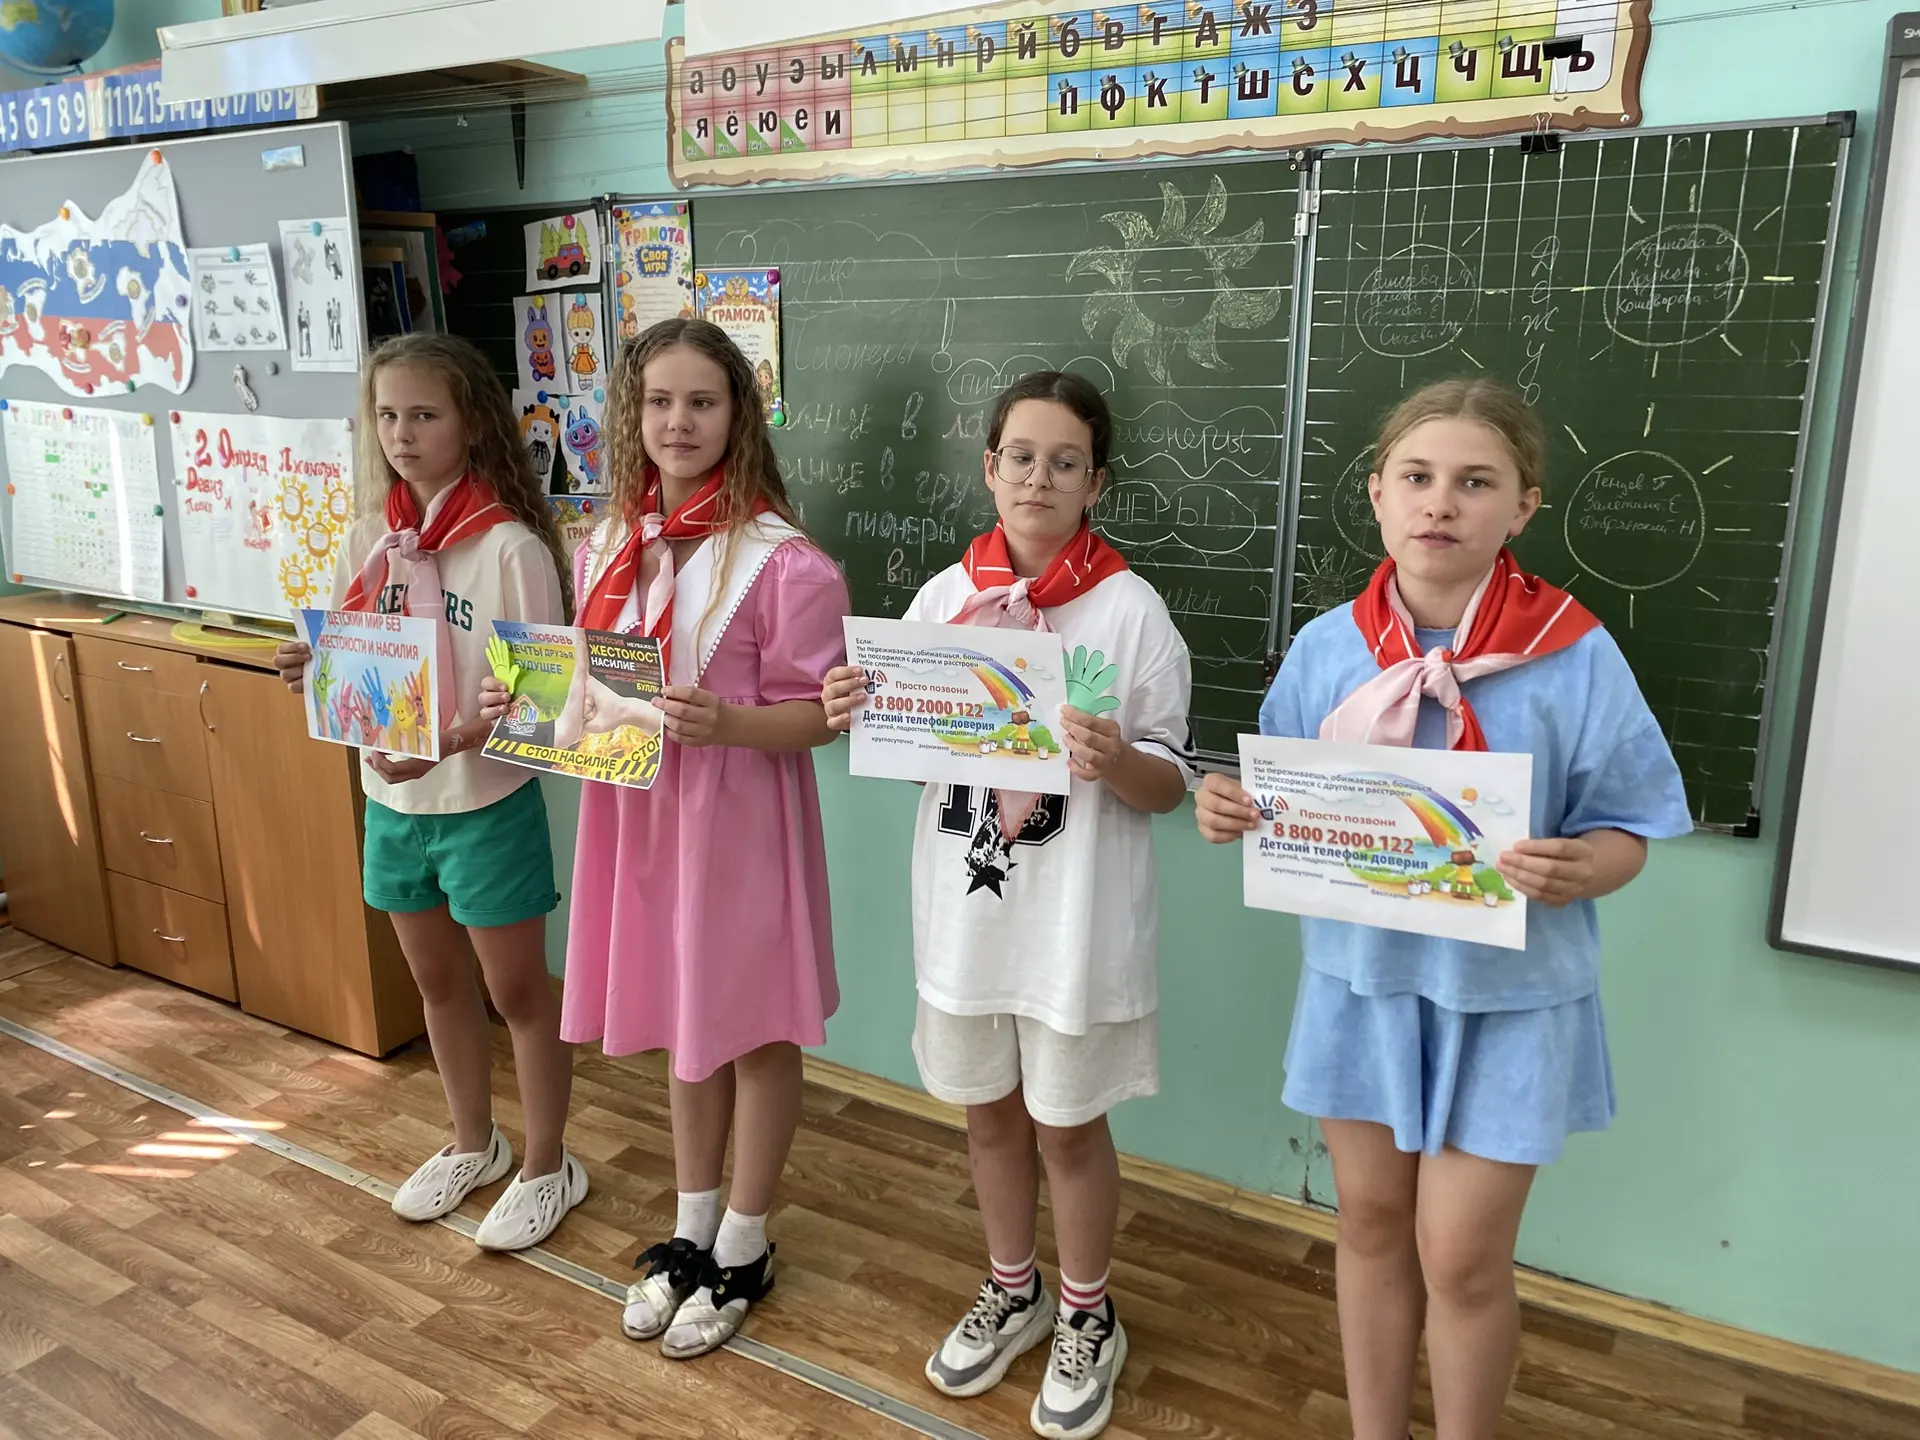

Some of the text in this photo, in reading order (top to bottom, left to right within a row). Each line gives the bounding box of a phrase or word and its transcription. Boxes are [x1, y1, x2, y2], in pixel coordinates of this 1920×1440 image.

[690, 69, 703, 93] а
[722, 64, 735, 89] о
[756, 62, 768, 96] у
[790, 58, 805, 83] э
[821, 53, 844, 79] ы
[861, 51, 876, 76] л
[896, 45, 918, 73] м
[937, 41, 954, 68] н
[977, 37, 993, 73] р
[1018, 21, 1036, 59] й
[1061, 18, 1079, 57] б
[1104, 23, 1124, 50] в
[1153, 17, 1168, 46] г
[1195, 13, 1218, 48] д
[1241, 4, 1272, 37] ж
[696, 116, 708, 138] я
[726, 111, 739, 136] ё
[759, 107, 777, 134] ю
[794, 105, 808, 130] е
[826, 109, 841, 134] и
[1060, 88, 1077, 114] п
[1101, 76, 1125, 120] ф
[1148, 79, 1167, 107] к
[1237, 69, 1268, 100] ш
[1294, 66, 1314, 96] с
[1342, 61, 1365, 91] х
[1396, 57, 1421, 93] ц
[1454, 49, 1476, 81] ч
[1501, 45, 1543, 83] щ
[8, 101, 18, 142] 5
[24, 98, 38, 140] 6
[40, 96, 51, 137] 7
[57, 94, 70, 135] 8
[73, 91, 86, 133] 9
[104, 86, 122, 127] 11
[125, 83, 144, 126] 12
[624, 226, 685, 247] ГРАМОТА
[640, 249, 668, 262] Своя
[712, 308, 765, 323] ГРАМОТА
[194, 428, 212, 468] 2
[566, 527, 593, 540] ГРАМ
[365, 614, 383, 628] МИР
[386, 617, 401, 632] БЕЗ
[318, 634, 418, 660] ЖЕСТОКОСТИ И НАСИЛИЯ
[529, 632, 573, 644] ЛЮБОВЬ
[867, 647, 915, 656] переживаешь,
[917, 650, 962, 660] обижаешься,
[868, 653, 905, 662] поссорился
[911, 657, 937, 666] другом
[943, 660, 979, 668] расстроен
[591, 656, 636, 671] НАСИЛИЕ
[895, 680, 969, 695] Просто позвони
[507, 704, 538, 723] ДОМ
[874, 695, 983, 718] 8 800 2000 122
[863, 710, 995, 732] Детский телефон доверия
[871, 737, 914, 746] круглосуточно
[918, 743, 950, 751] анонимно
[526, 746, 616, 770] СТОП НАСИЛИЕ
[951, 750, 982, 759] бесплатно
[1253, 758, 1275, 766] Если:
[1253, 766, 1265, 774] ты
[1266, 766, 1329, 781] переживаешь,
[1330, 774, 1390, 788] обижаешься,
[1254, 774, 1265, 783] ты
[1267, 775, 1315, 788] поссорился
[1323, 781, 1355, 793] другом
[1366, 786, 1412, 798] расстроен
[1255, 782, 1273, 790] тебе
[1299, 808, 1396, 828] Просто позвони
[1273, 822, 1414, 855] 8 800 2000 122
[1259, 837, 1428, 870] Детский телефон доверия
